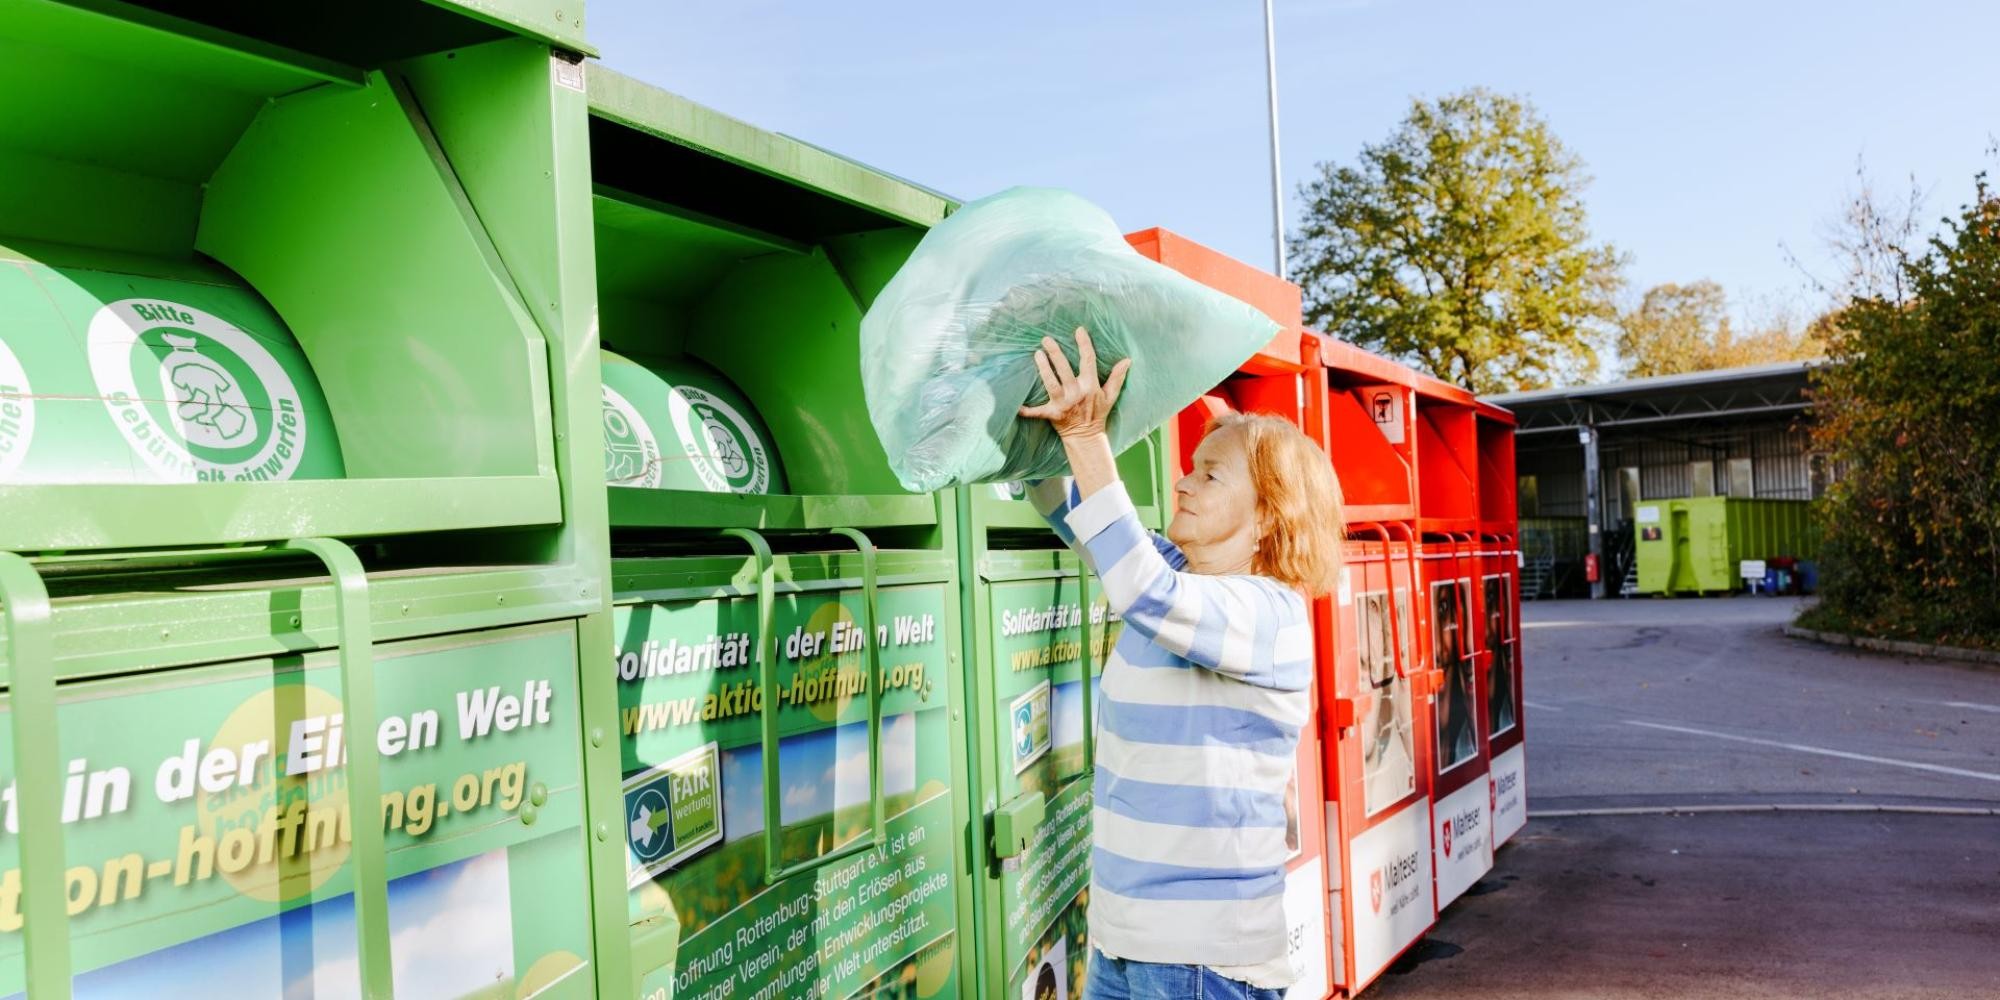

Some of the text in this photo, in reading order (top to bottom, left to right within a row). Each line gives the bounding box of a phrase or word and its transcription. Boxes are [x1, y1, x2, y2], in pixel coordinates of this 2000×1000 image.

[131, 303, 195, 326] Bitte
[234, 398, 297, 482] einwerfen
[786, 626, 826, 660] der
[830, 621, 888, 654] Einn
[894, 613, 935, 645] Welt
[1002, 605, 1069, 637] Solidarität
[622, 660, 926, 736] www.aktio-hoffnun.org
[61, 757, 131, 824] in
[155, 738, 269, 803] der
[286, 708, 439, 776] Eien
[456, 679, 553, 741] Welt
[672, 766, 710, 804] FAIR
[675, 794, 712, 821] wertung
[1453, 806, 1480, 839] Malteser
[736, 856, 866, 952] Rottenburg-Stuttgart
[868, 845, 888, 869] e.V.
[891, 834, 905, 856] ist
[908, 825, 925, 847] ein
[1384, 850, 1418, 891] Malteser
[739, 944, 784, 984] Verein,
[787, 924, 809, 951] der
[811, 909, 829, 936] mit
[833, 896, 855, 922] den
[858, 869, 902, 906] Erlösen
[904, 855, 926, 879] aus
[748, 949, 822, 1000] mmlungen
[824, 872, 949, 960] Entwicklungsprojekte
[834, 956, 861, 985] Welt
[864, 910, 929, 965] unterstützt.
